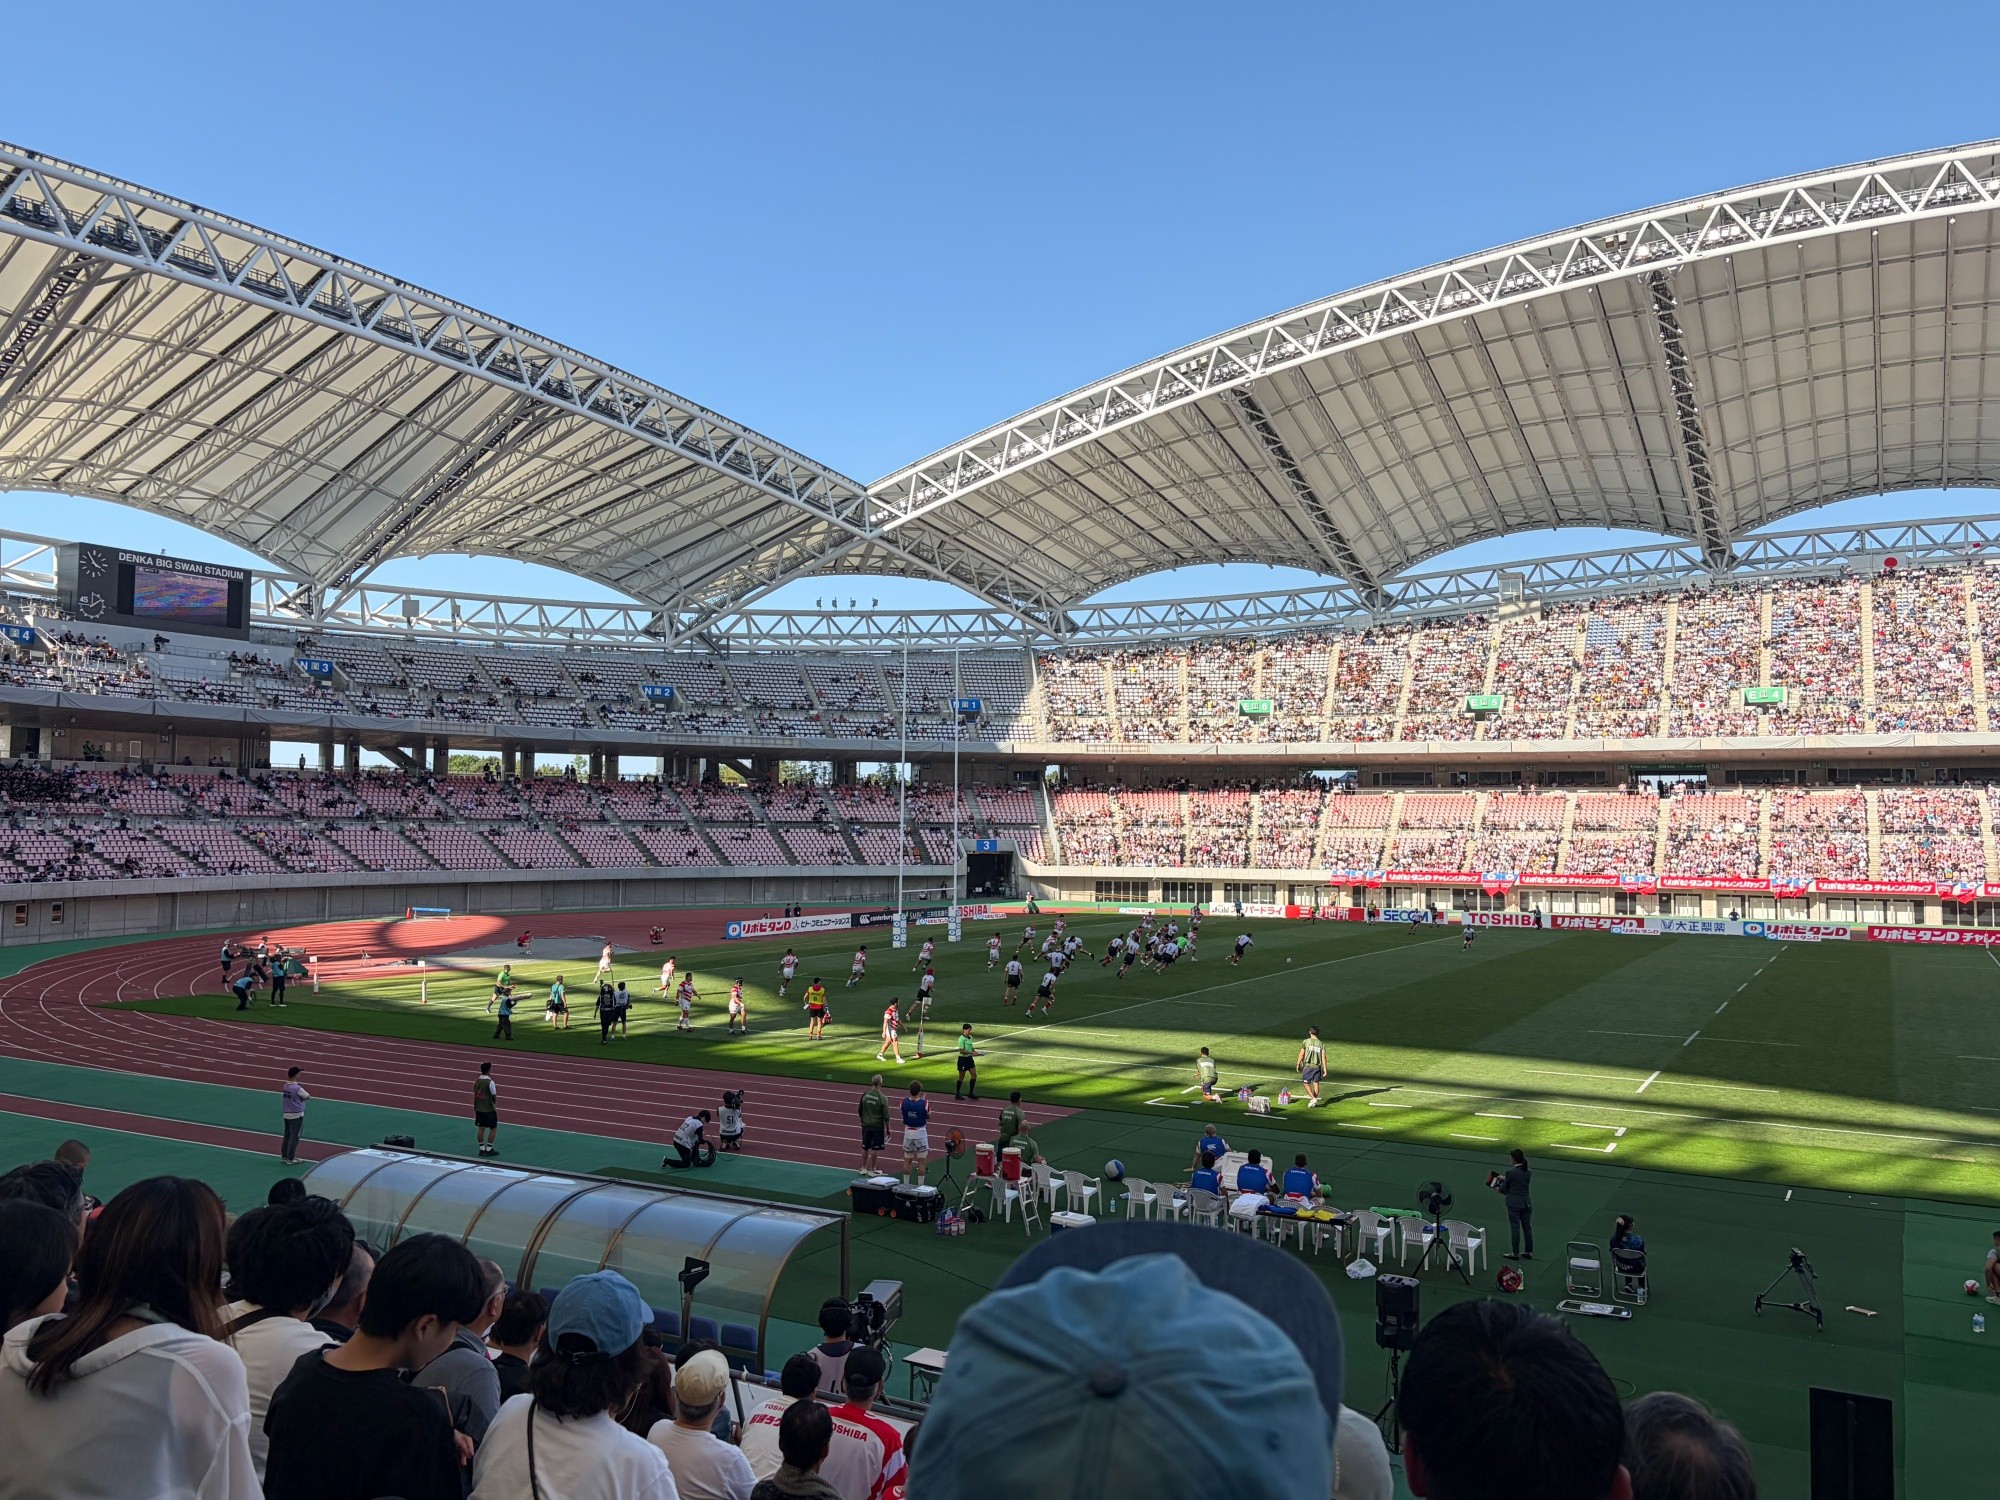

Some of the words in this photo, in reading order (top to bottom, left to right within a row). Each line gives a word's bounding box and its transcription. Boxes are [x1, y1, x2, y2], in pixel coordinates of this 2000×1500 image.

[118, 552, 153, 566] DENKA
[155, 558, 173, 569] BIG
[174, 561, 203, 573] SWAN
[204, 567, 244, 580] STADIUM
[22, 630, 30, 641] 4
[300, 660, 308, 670] N
[322, 663, 329, 672] 3
[644, 687, 652, 696] N
[664, 688, 670, 696] 2
[1749, 691, 1757, 700] E
[1772, 690, 1779, 699] 4
[1244, 702, 1250, 710] E
[1262, 702, 1268, 710] 6
[1471, 698, 1478, 706] E
[1491, 698, 1498, 706] 5
[983, 841, 990, 850] 3
[957, 905, 988, 917] OSHIBA
[1675, 920, 1726, 932] 大正製薬
[1873, 928, 1960, 942] リポビタンD
[727, 1115, 734, 1124] 51
[832, 1423, 868, 1442] OSHIBA
